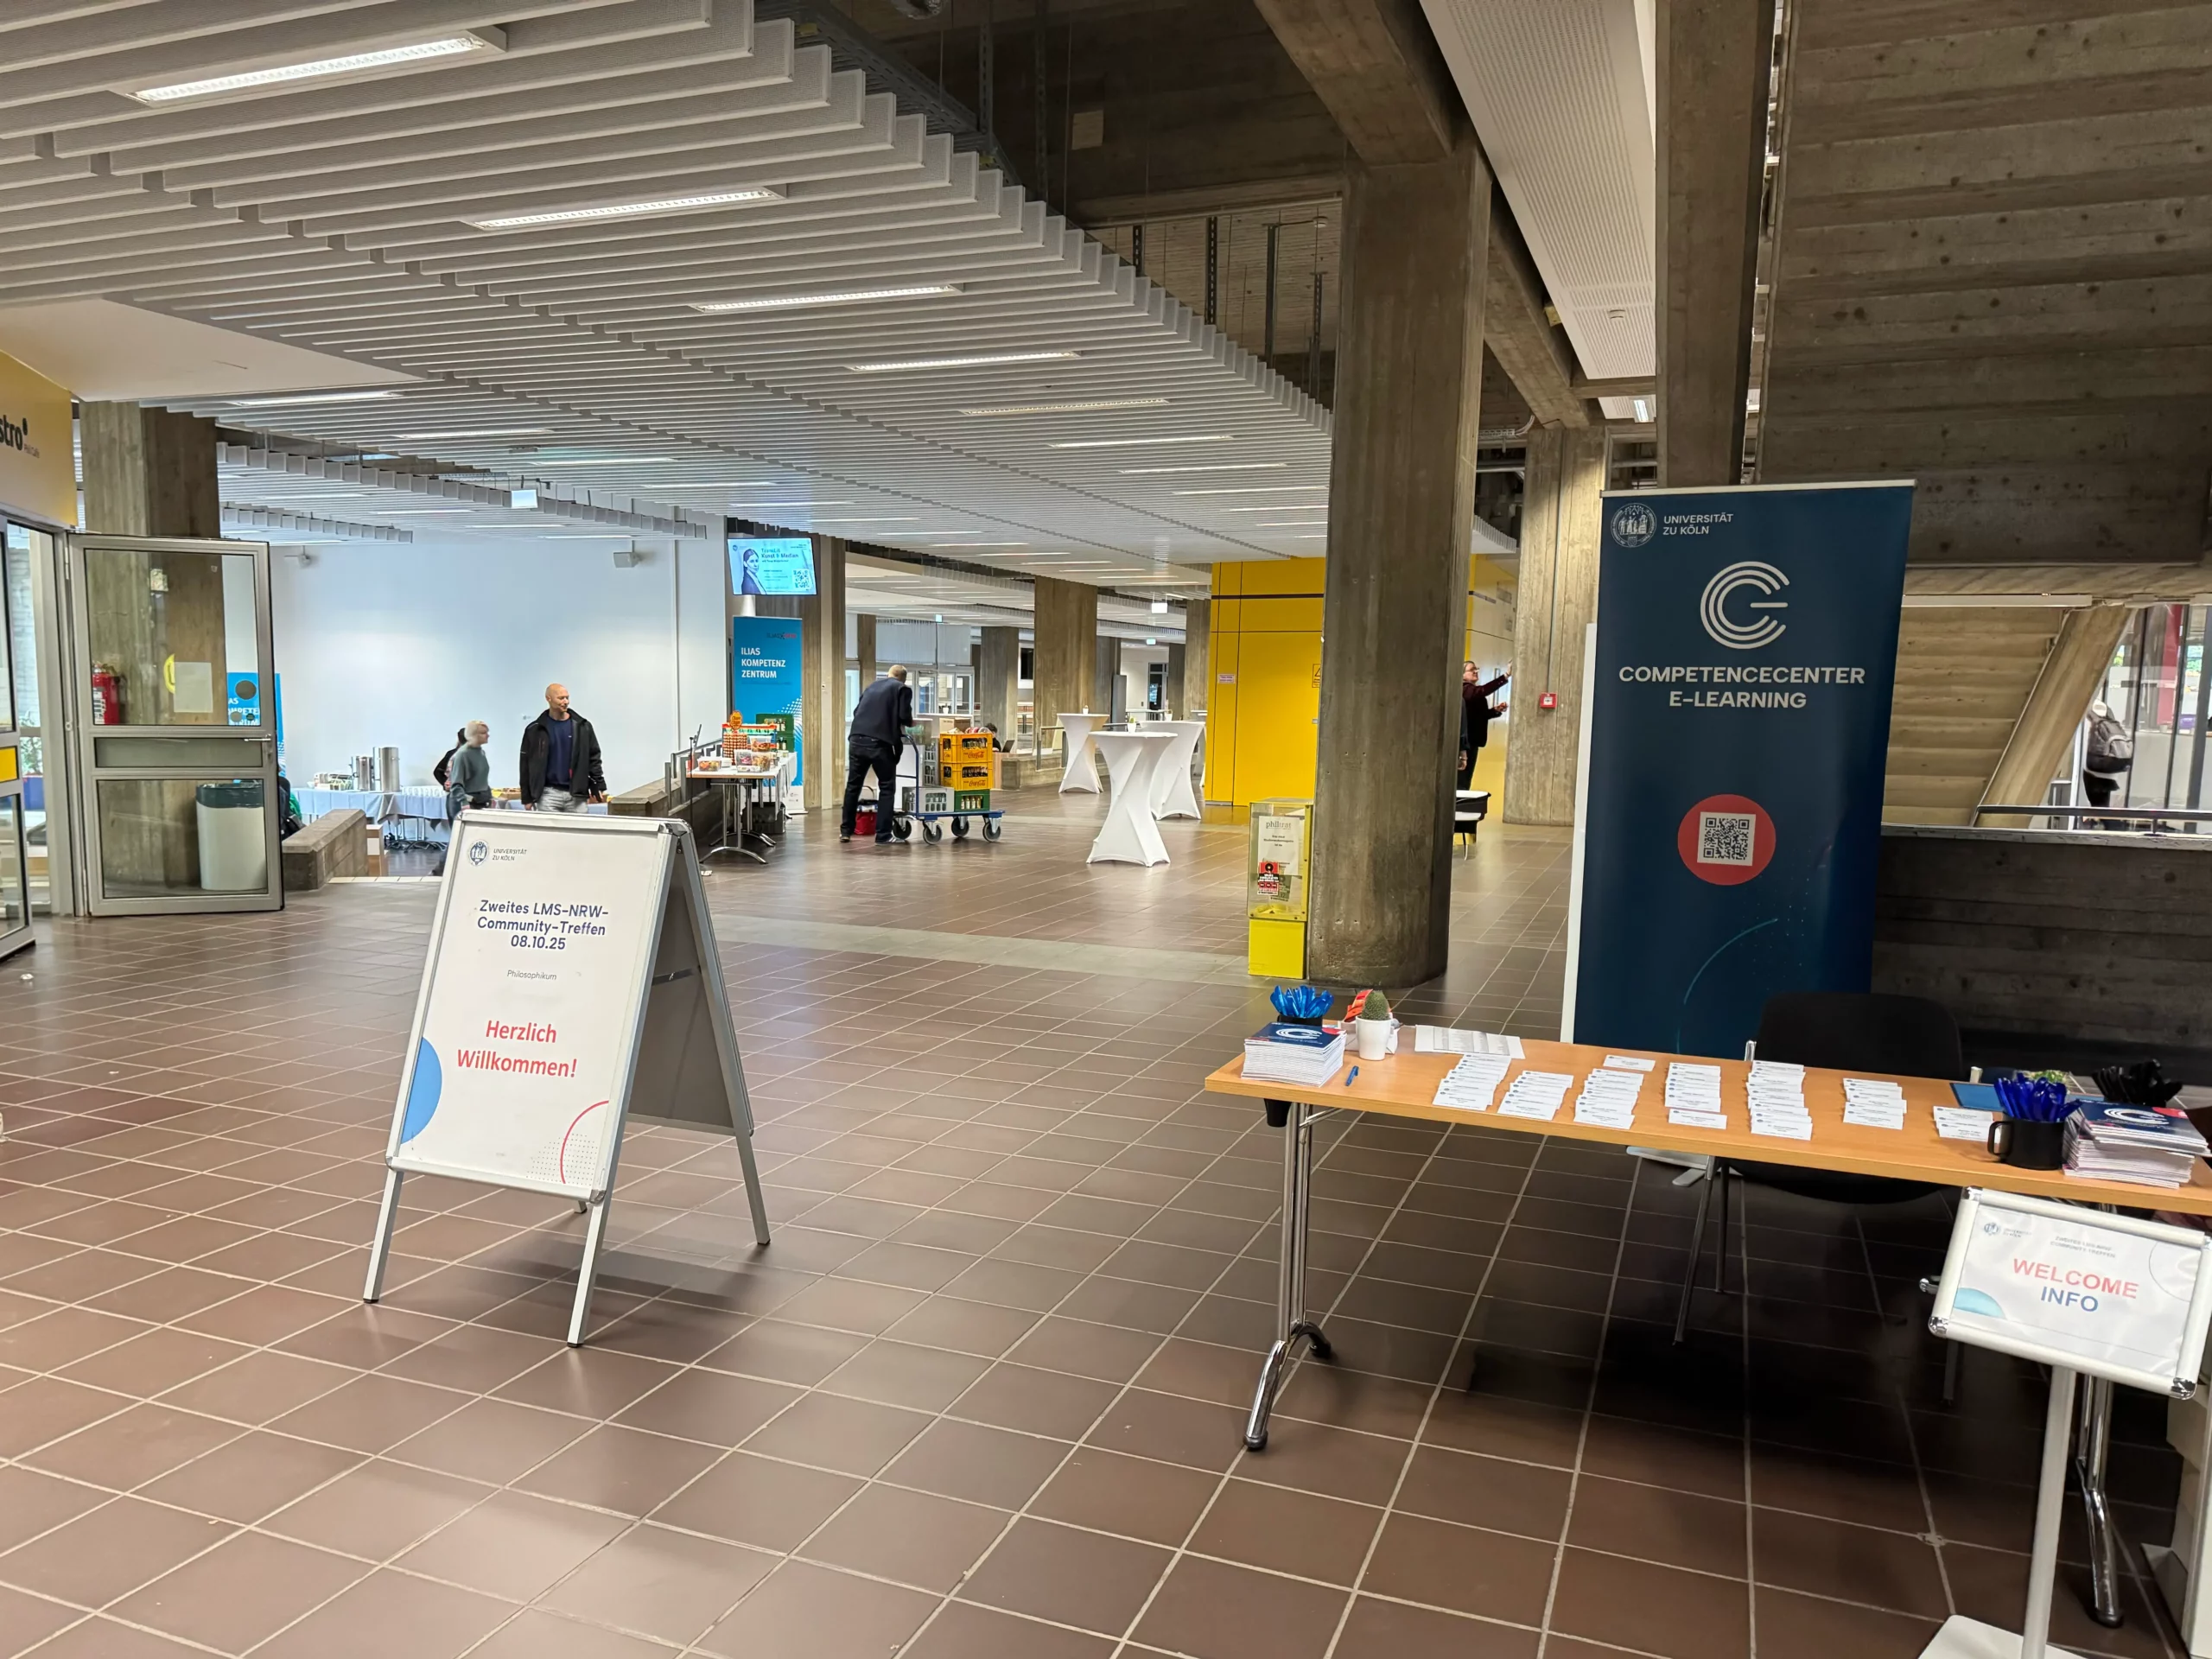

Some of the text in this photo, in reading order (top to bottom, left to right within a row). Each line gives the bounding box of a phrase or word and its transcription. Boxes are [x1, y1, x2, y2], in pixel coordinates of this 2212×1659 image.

[1663, 512, 1733, 524] UNIVERSITÄT
[1662, 524, 1709, 535] ZU KÖLN
[741, 658, 786, 668] KOMPETENZ
[741, 670, 777, 678] ZENTRUM
[1618, 666, 1866, 684] COMPETENCECENTER
[1669, 691, 1807, 709] E-LEARNING
[480, 899, 609, 918] Zweites LMS-NRW-
[478, 916, 606, 935] Community-Treffen
[511, 935, 566, 950] 08.10.25
[507, 969, 557, 980] Philosophikum
[486, 1020, 557, 1043] Herzlich
[458, 1049, 577, 1077] Willkommen!
[2013, 1258, 2139, 1299] WELCOME
[2040, 1286, 2099, 1312] INFO
